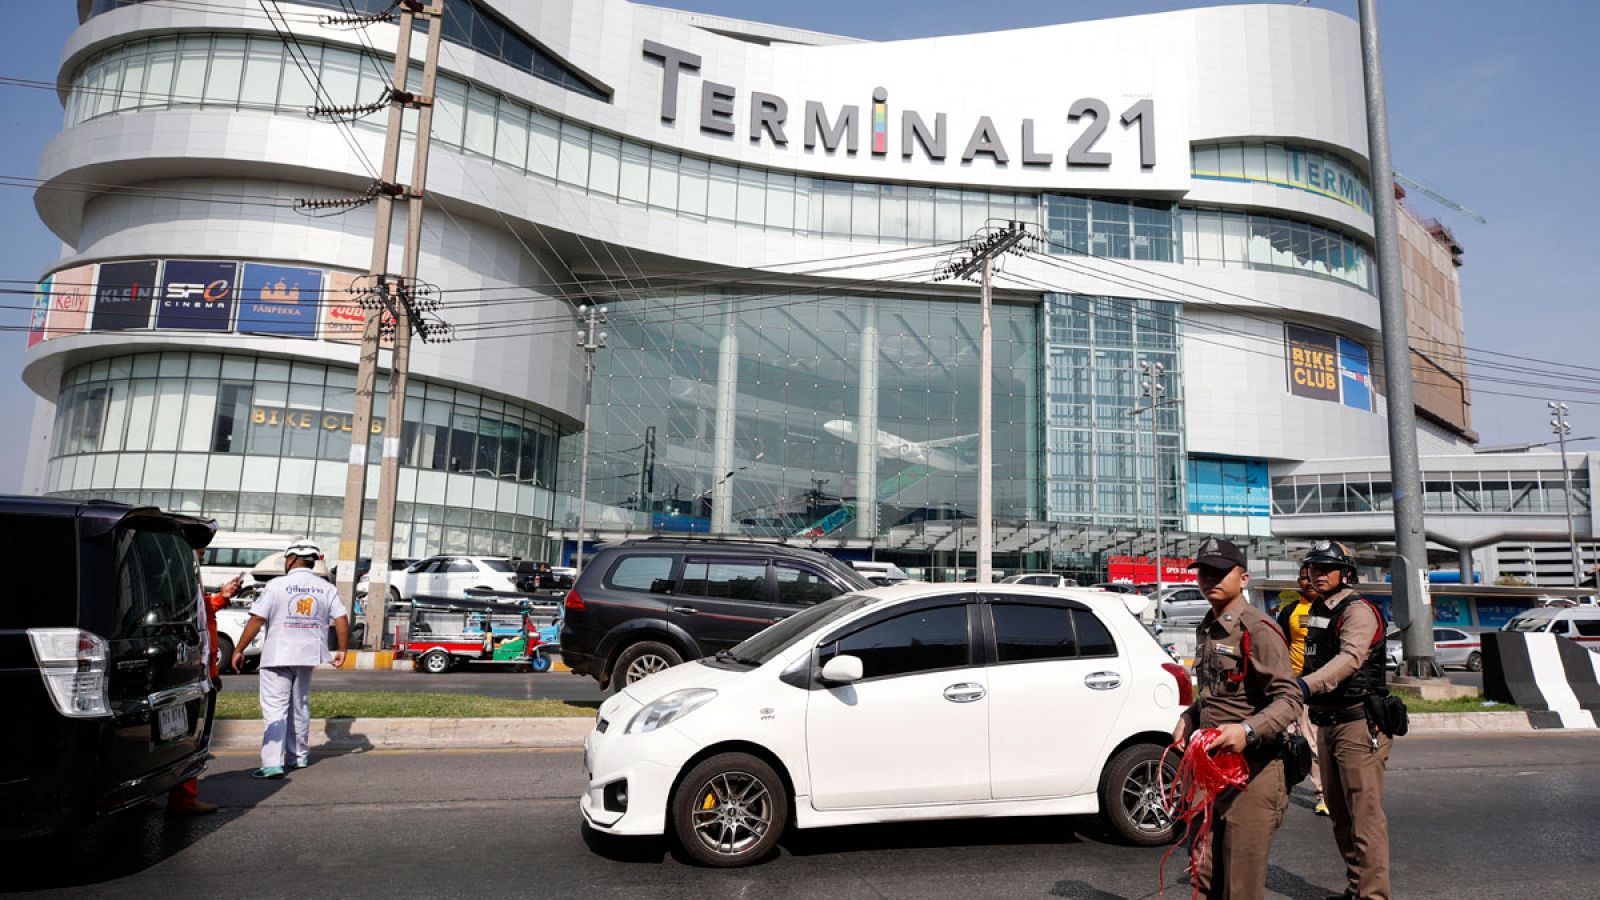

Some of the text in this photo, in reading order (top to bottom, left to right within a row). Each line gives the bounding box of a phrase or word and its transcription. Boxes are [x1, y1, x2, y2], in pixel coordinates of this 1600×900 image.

[1067, 97, 1157, 168] 21
[100, 281, 152, 302] KLEIN
[164, 300, 225, 309] CINEMA
[1292, 347, 1335, 372] BIKE
[1294, 367, 1337, 390] CLUB
[253, 407, 383, 435] BIKE CLB
